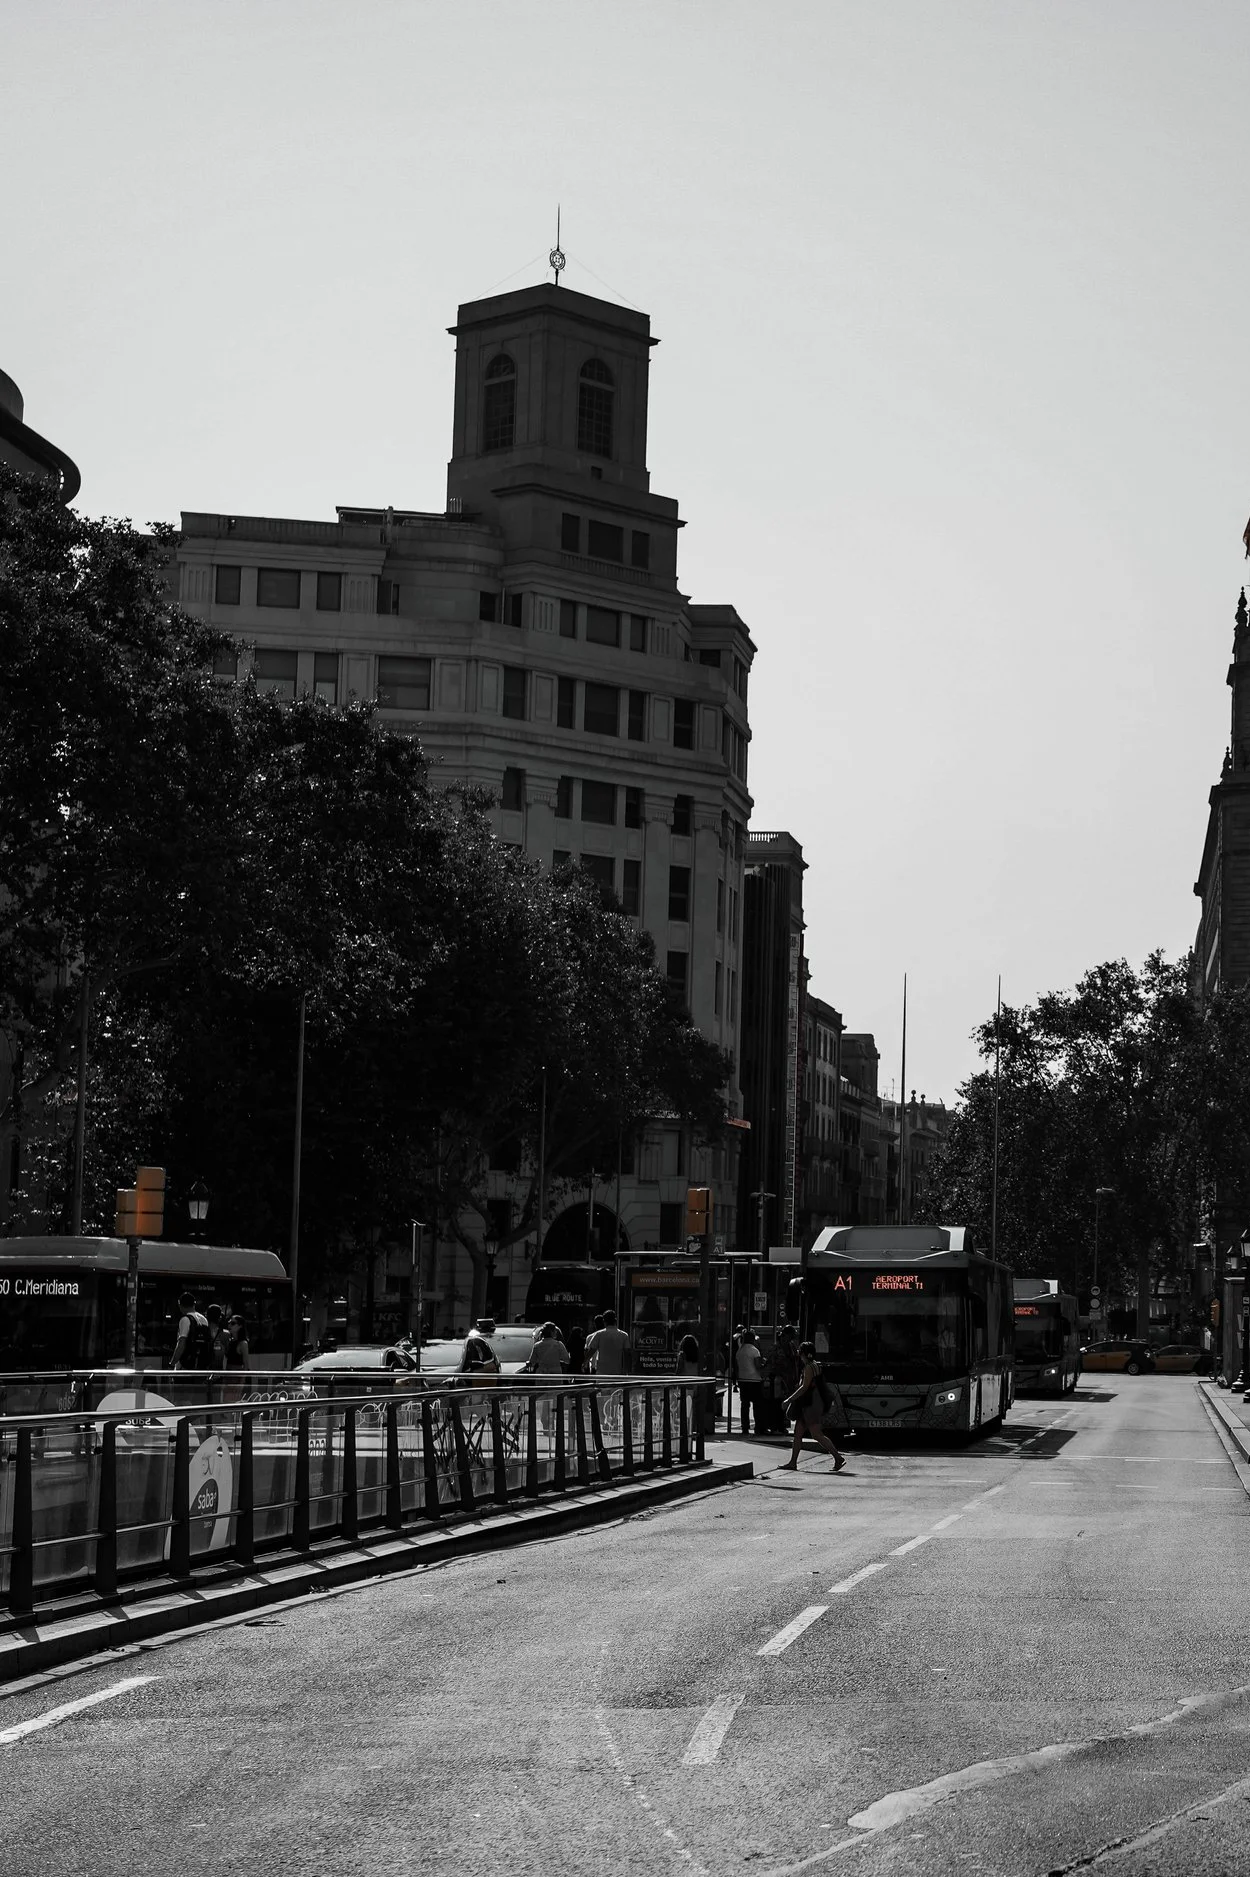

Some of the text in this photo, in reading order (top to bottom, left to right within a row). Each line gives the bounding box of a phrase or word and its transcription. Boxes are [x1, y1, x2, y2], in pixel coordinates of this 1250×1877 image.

[639, 1275, 700, 1284] www.barcelona.ca
[834, 1275, 919, 1291] A1 AEROPORT
[15, 1279, 79, 1296] C.Meridiana
[871, 1282, 924, 1290] TERMINAL T1
[544, 1294, 583, 1302] BLUE ROUTE
[378, 1312, 402, 1321] KFC
[197, 1488, 214, 1509] saba
